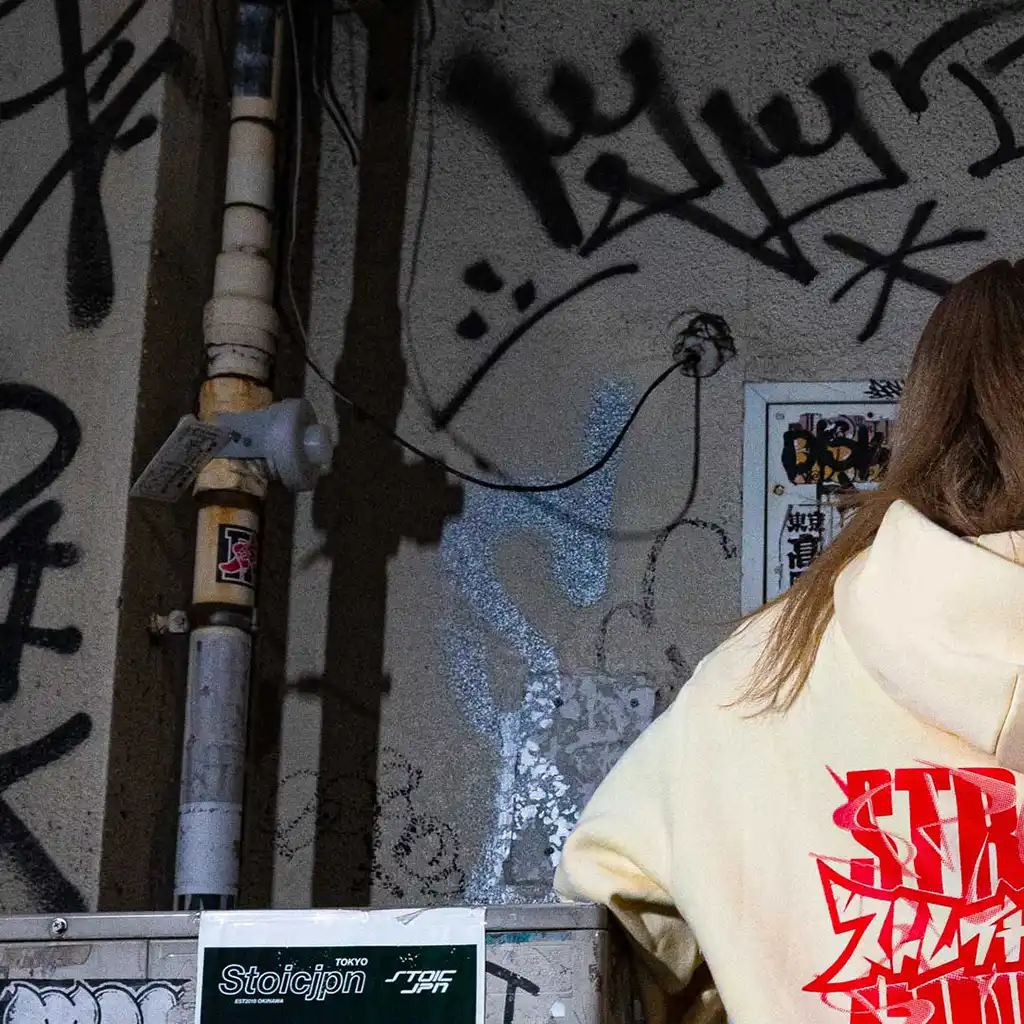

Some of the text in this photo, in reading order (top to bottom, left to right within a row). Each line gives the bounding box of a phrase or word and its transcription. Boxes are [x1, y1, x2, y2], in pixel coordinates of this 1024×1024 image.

[335, 957, 368, 967] TOKYO
[218, 963, 367, 1001] Stoicjpn
[385, 969, 457, 983] STOIC
